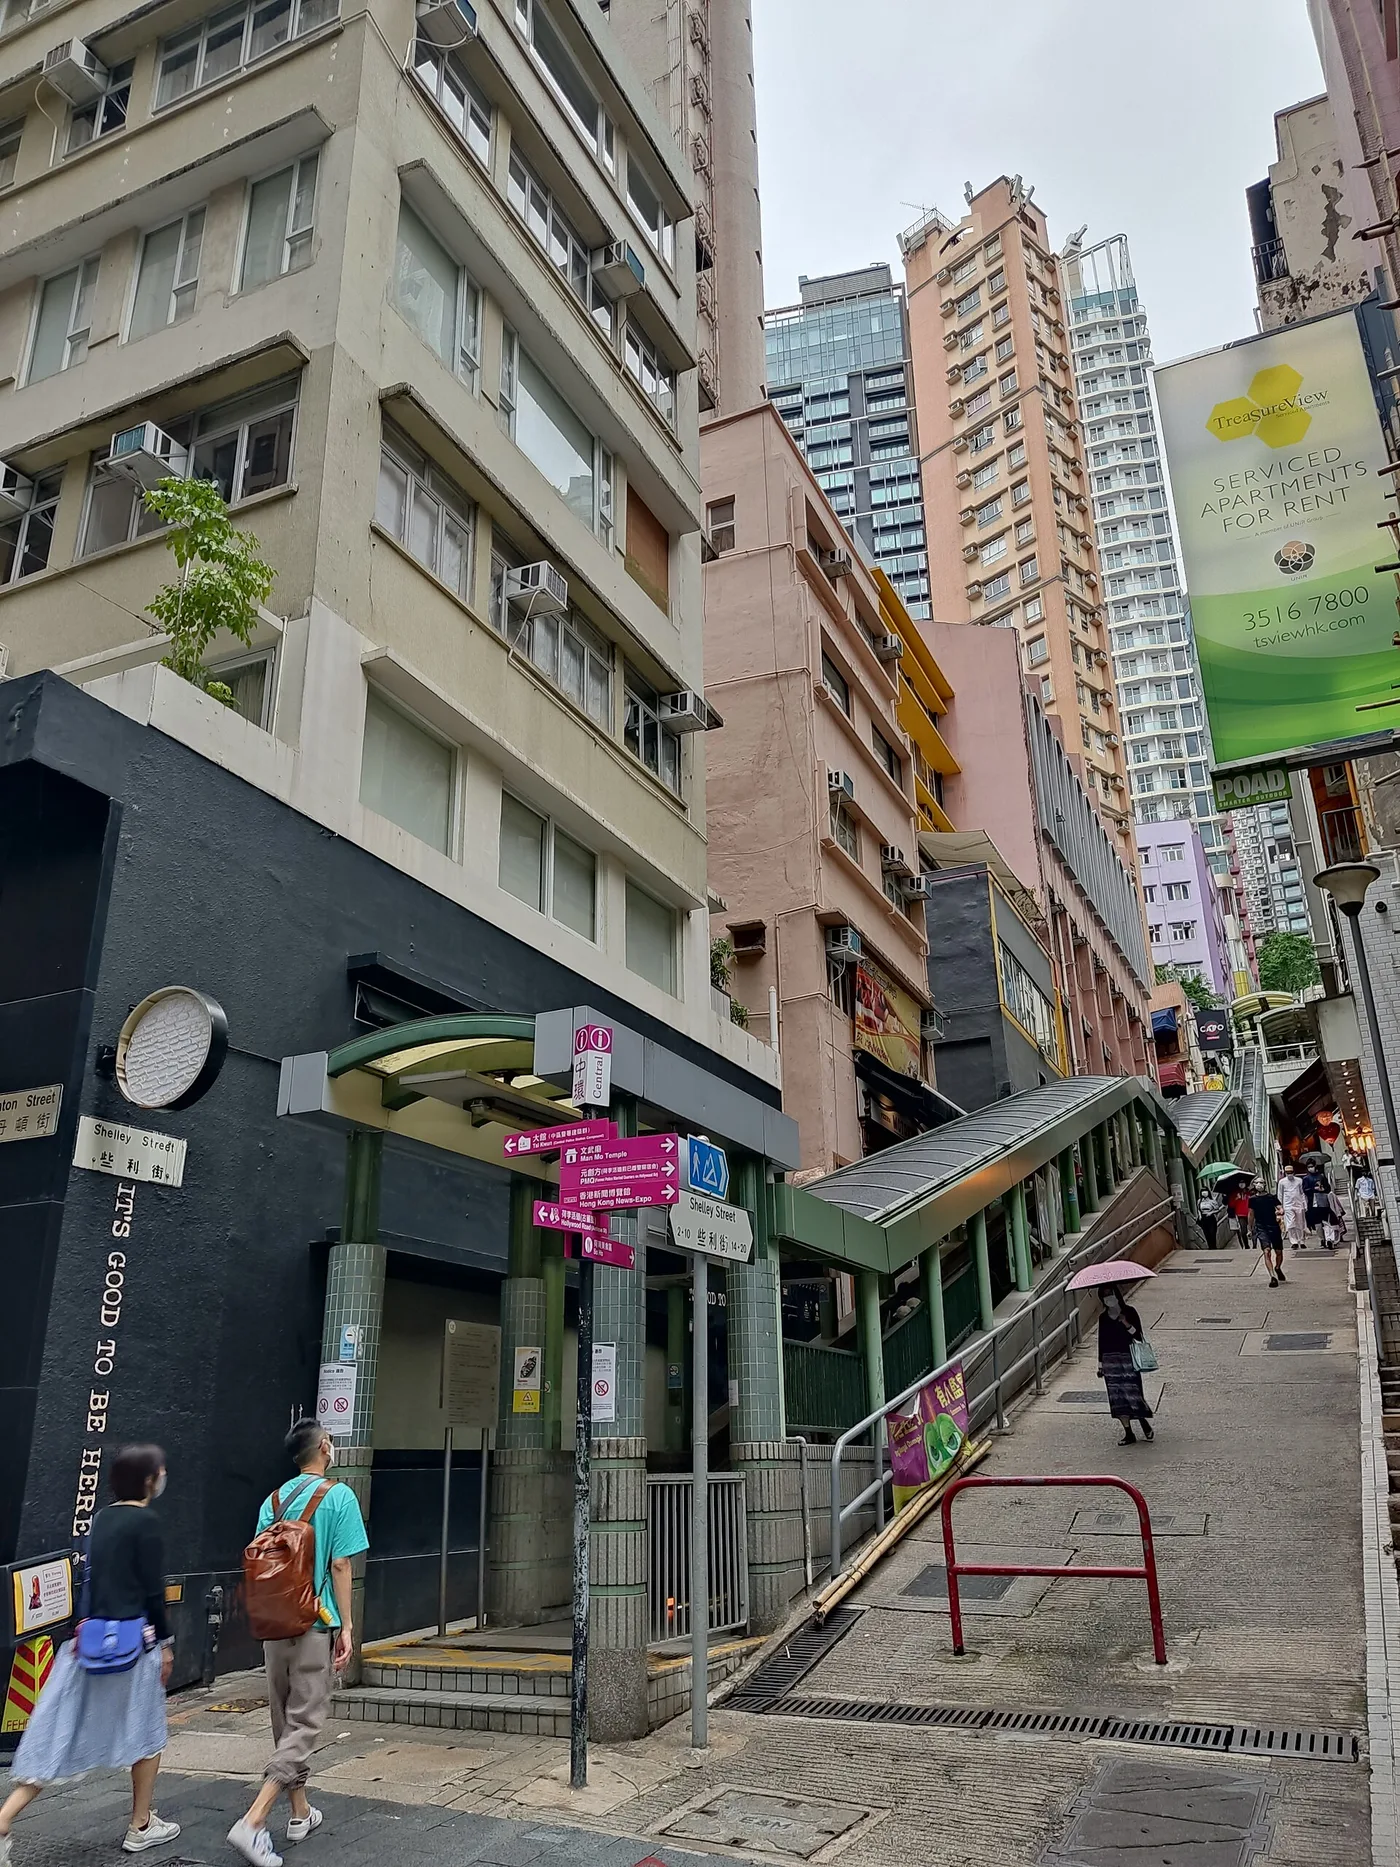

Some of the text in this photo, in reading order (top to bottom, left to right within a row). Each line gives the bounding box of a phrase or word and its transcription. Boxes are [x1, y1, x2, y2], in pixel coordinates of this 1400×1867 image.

[1213, 447, 1342, 493] SERVICED
[1200, 460, 1367, 519] APARTMENTS
[1222, 486, 1350, 534] FOR RENT
[1306, 515, 1323, 523] Group
[1242, 586, 1369, 631] 3516 7800
[1252, 614, 1366, 648] tsviewhk.com
[1215, 769, 1286, 802] POAD
[1219, 790, 1288, 808] SMARTER OUTDOOR
[573, 1057, 586, 1100] 中環
[592, 1055, 604, 1099] Central
[0, 1092, 56, 1112] ton Street
[93, 1123, 175, 1153] Shelley Street
[100, 1151, 164, 1180] 些利街
[580, 1150, 628, 1163] Man Mo Temple
[580, 1177, 595, 1185] PMQ
[579, 1199, 596, 1209] Hong
[597, 1198, 615, 1208] Kong
[615, 1195, 652, 1205] News-Expo
[689, 1196, 736, 1223] Shelley Street
[697, 1227, 729, 1253] 些利街
[72, 1182, 136, 1537] IT'S GOOD TO BE HERE
[6, 1717, 29, 1731] FEH
